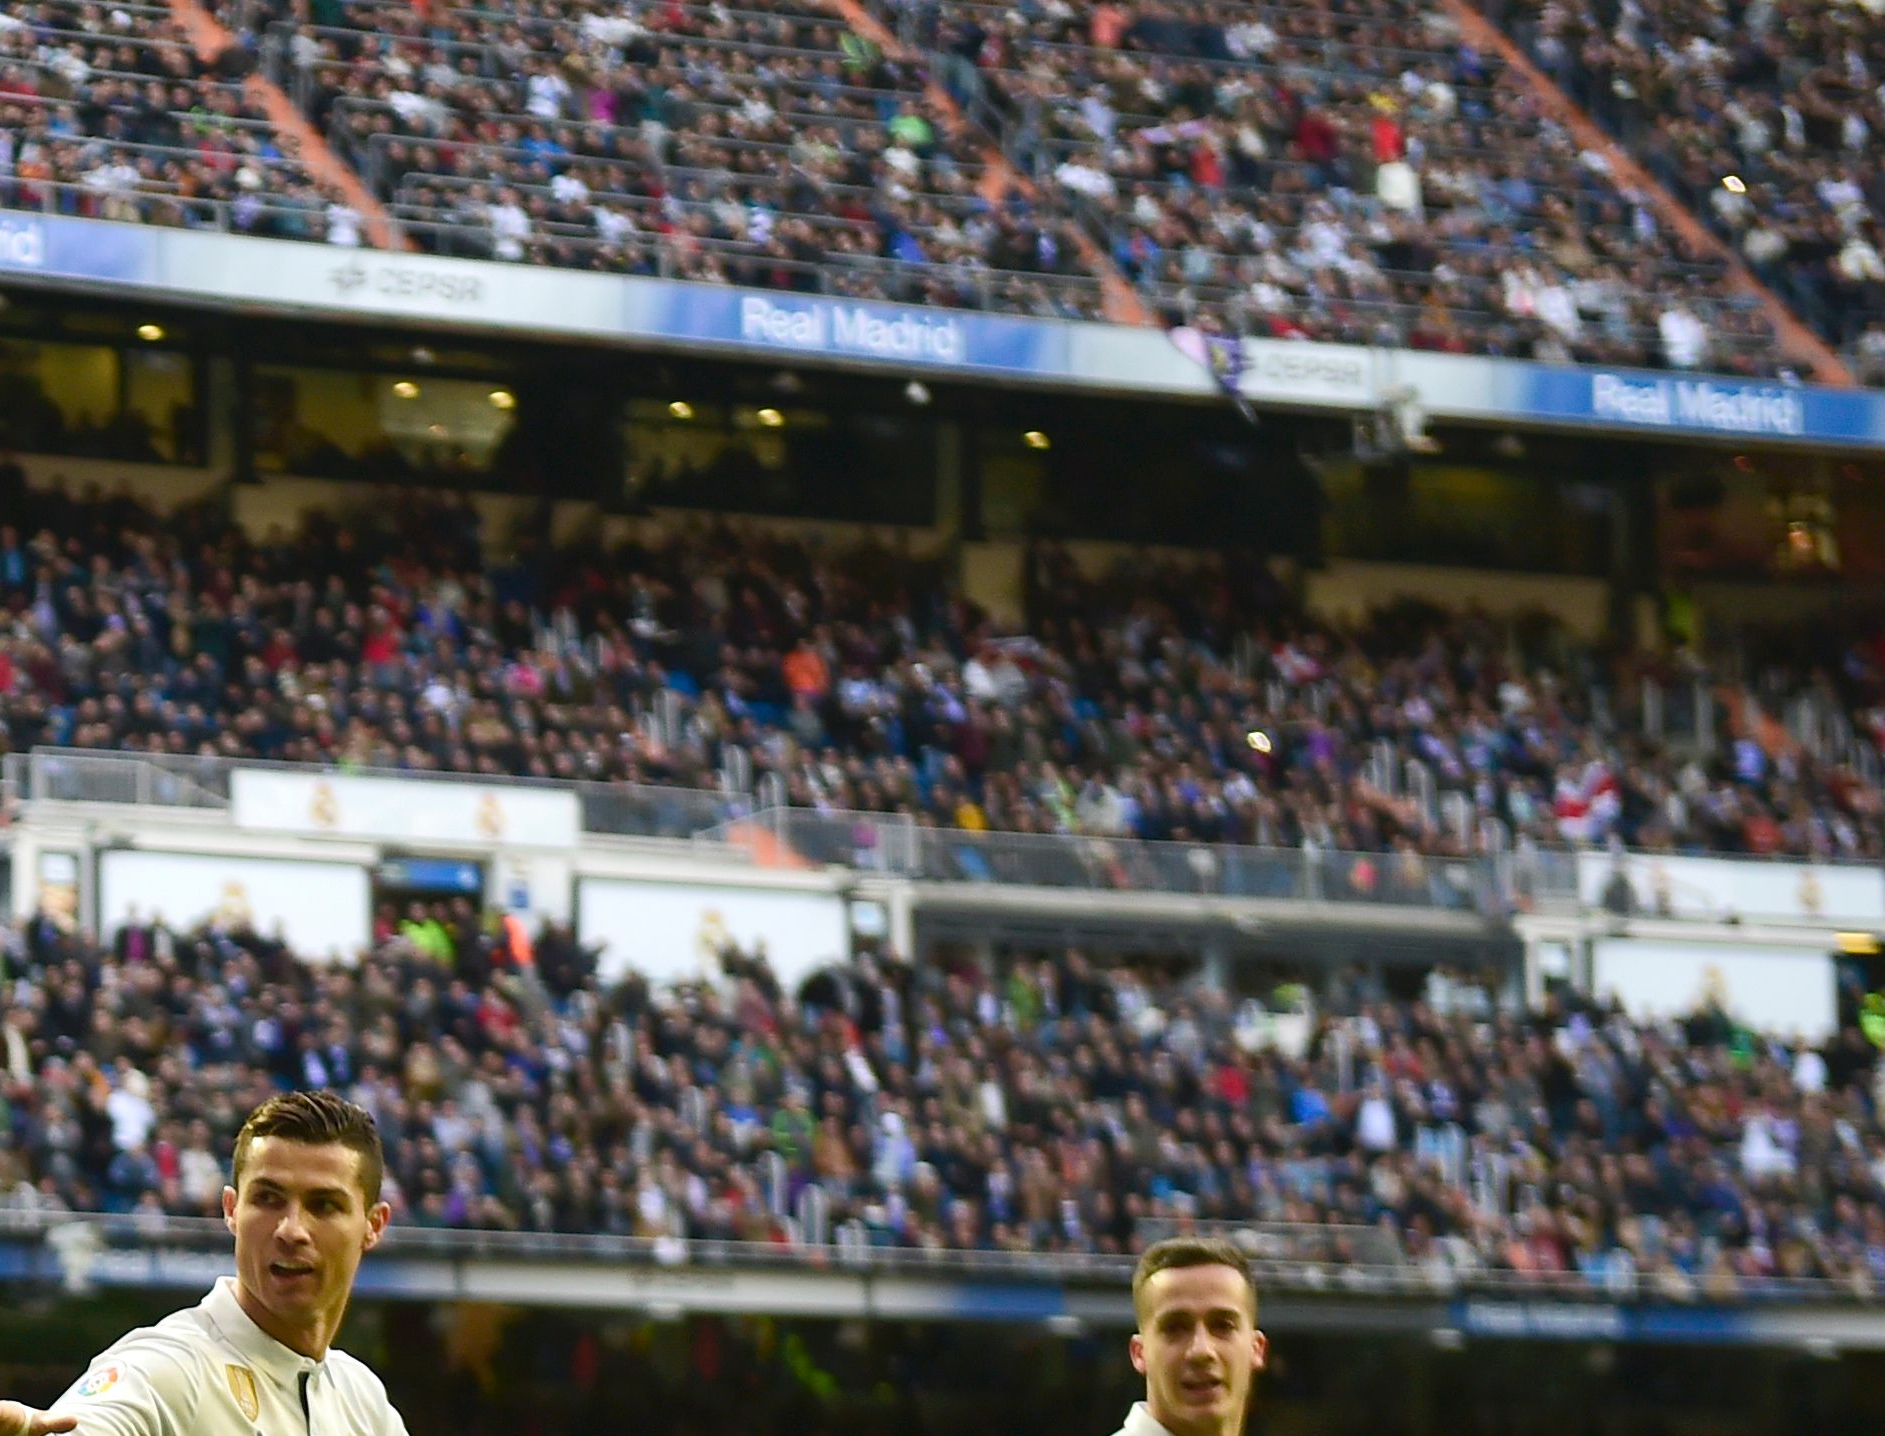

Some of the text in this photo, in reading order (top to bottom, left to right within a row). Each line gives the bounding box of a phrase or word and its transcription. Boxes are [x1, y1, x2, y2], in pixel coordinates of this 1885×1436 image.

[742, 296, 962, 364] Real Madrid
[1592, 373, 1672, 426] Real
